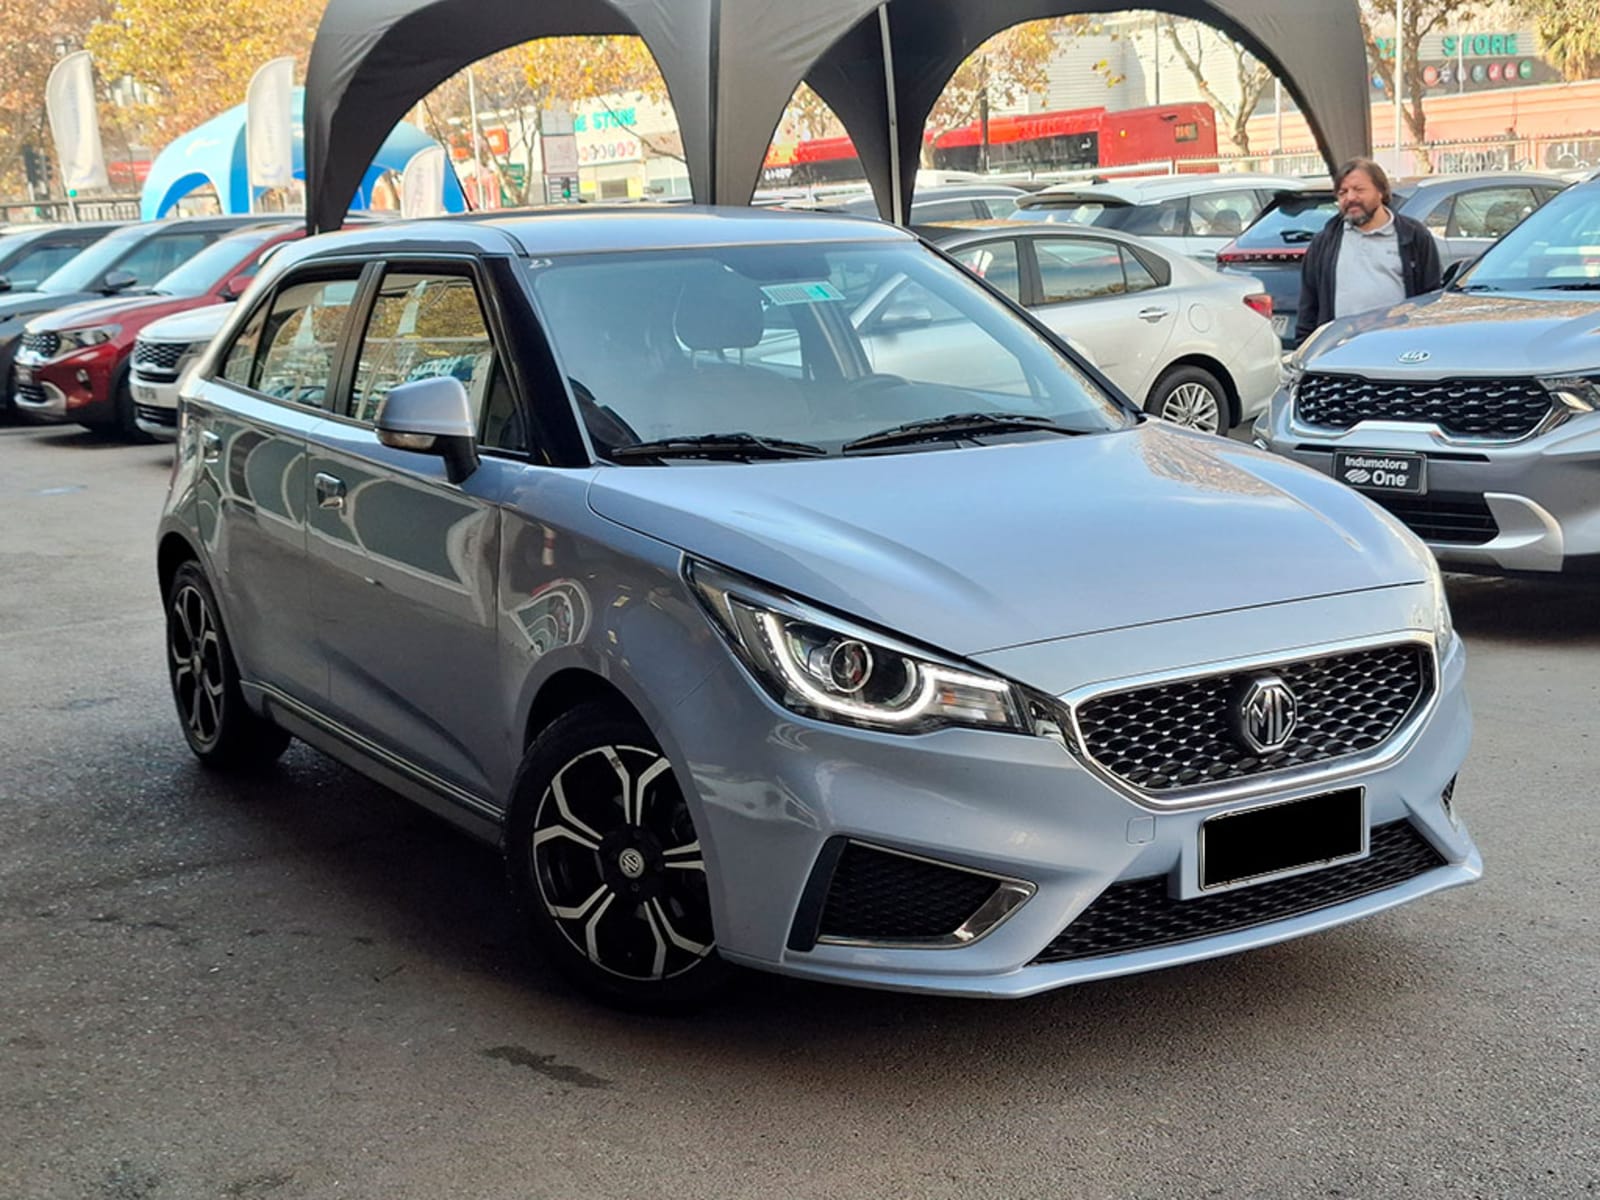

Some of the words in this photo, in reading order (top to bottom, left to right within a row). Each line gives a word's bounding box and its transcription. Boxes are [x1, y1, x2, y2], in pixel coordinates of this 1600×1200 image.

[1442, 33, 1518, 57] STORE
[1345, 456, 1409, 470] Indumotora
[1372, 470, 1407, 487] One
[1249, 686, 1294, 745] MG
